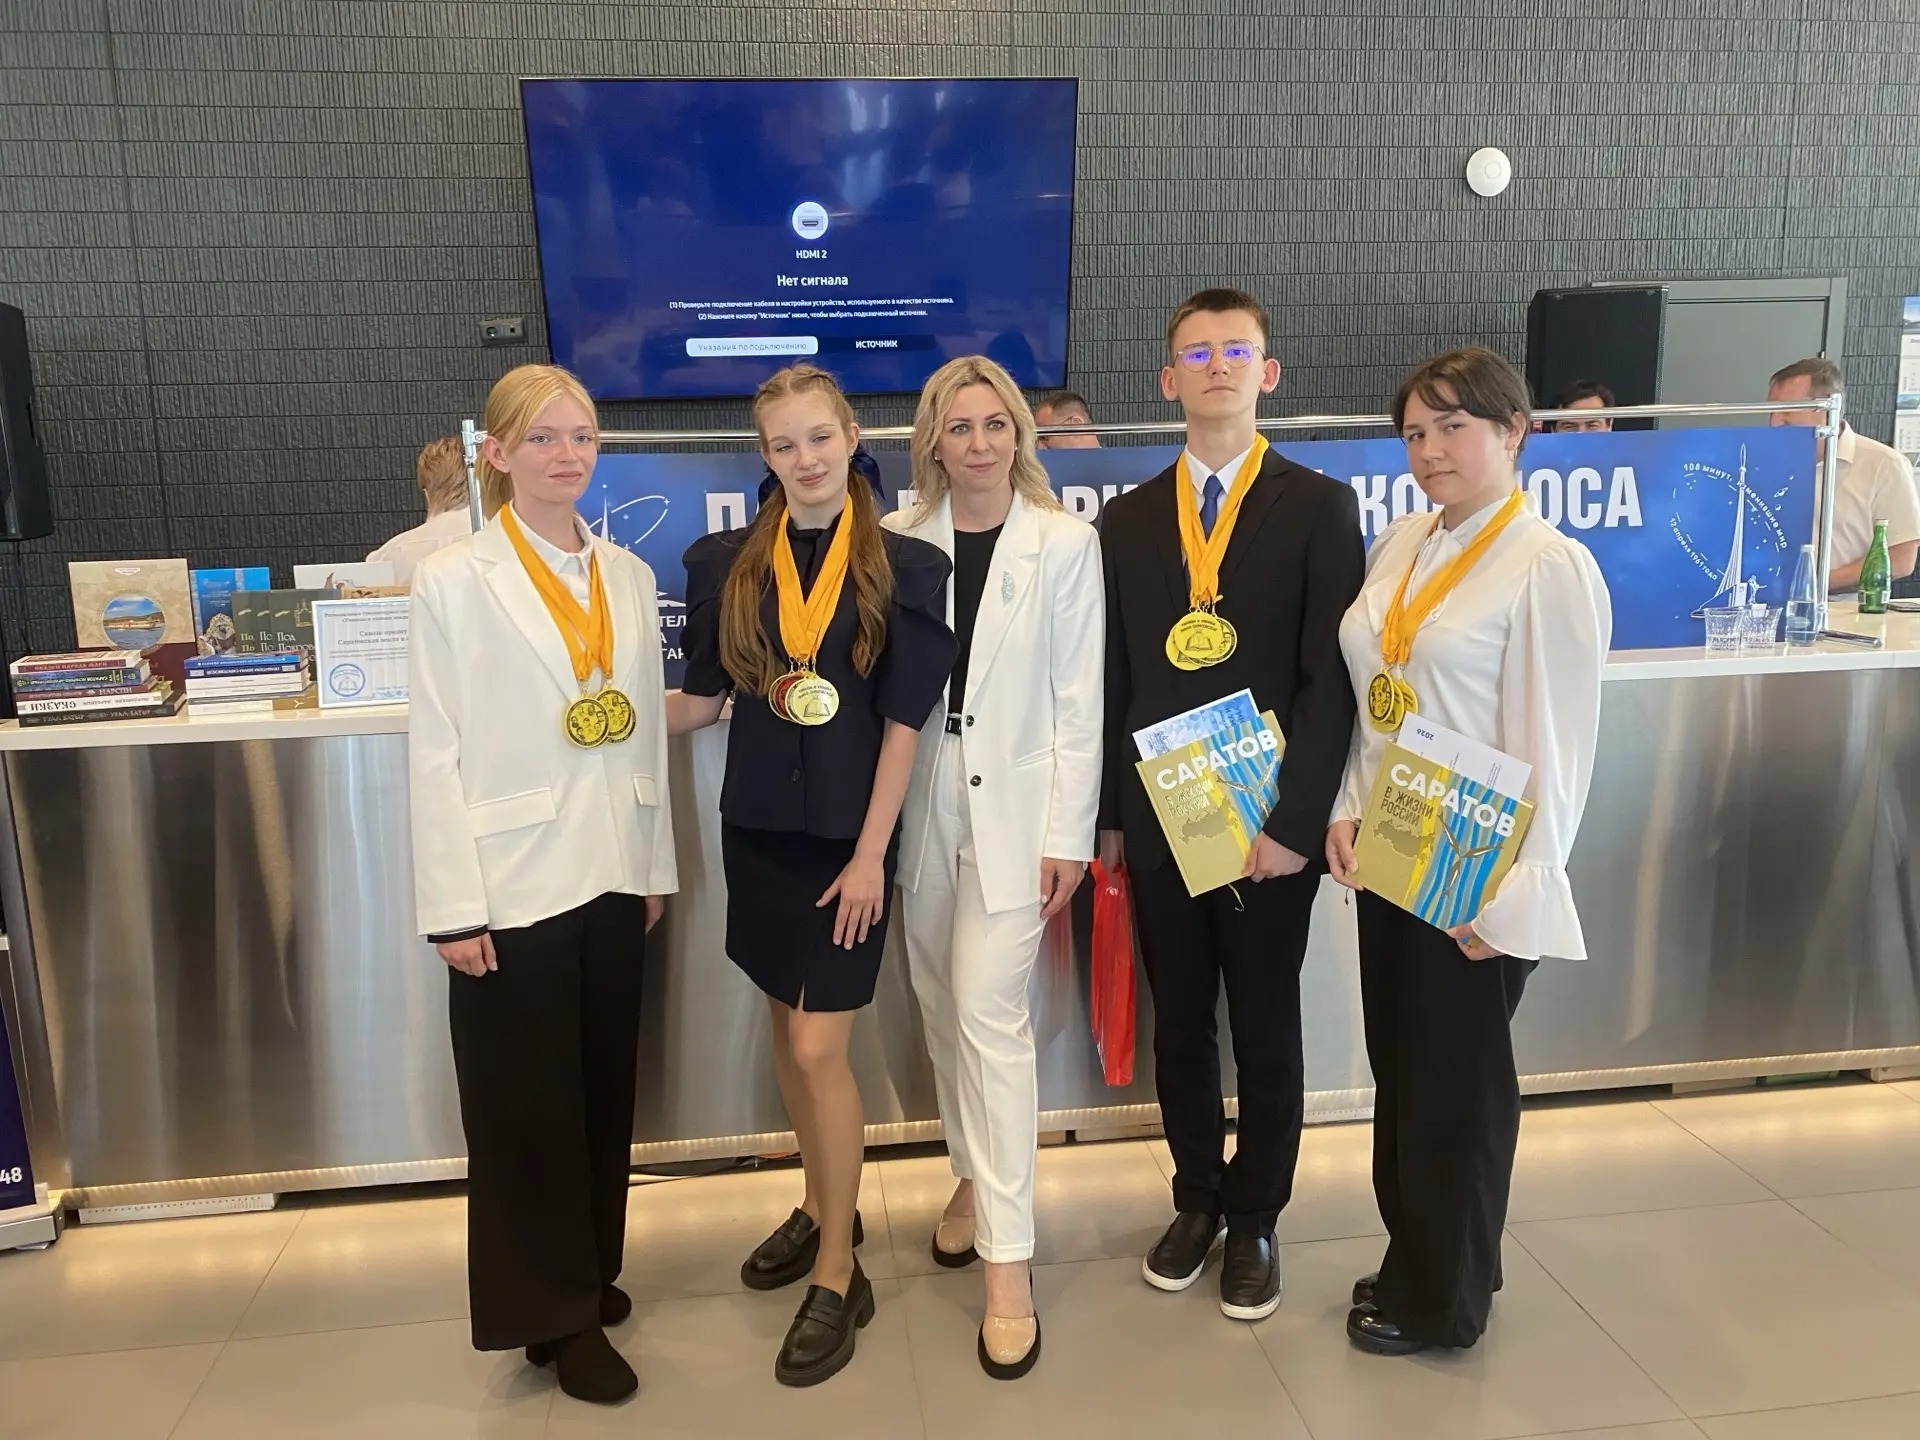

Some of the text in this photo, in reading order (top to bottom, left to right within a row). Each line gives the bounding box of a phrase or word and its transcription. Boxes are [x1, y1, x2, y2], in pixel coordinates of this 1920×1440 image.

[796, 250, 827, 259] HDMI 2
[777, 275, 848, 288] Нет сигнала
[669, 301, 678, 309] (1)
[678, 301, 710, 309] Проверьте
[711, 301, 753, 309] подключение
[698, 312, 707, 320] (2)
[810, 310, 828, 318] чтобы
[829, 310, 853, 318] выбрать
[698, 344, 737, 352] Указания
[750, 343, 807, 351] подключению
[855, 340, 898, 349] ИСТОЧНИК
[1351, 466, 1643, 537] КООСА
[1683, 463, 1701, 471] 108
[1702, 464, 1733, 482] минут,
[1776, 528, 1788, 549] мир
[1669, 517, 1718, 581] 12 апреля 1961 года
[30, 700, 77, 712] СКАЗКИ
[1416, 728, 1435, 740] 2026
[1156, 729, 1278, 790] САРАТОВ
[1384, 785, 1434, 820] В ЖИЗНИ
[1390, 763, 1516, 838] САРАТОВ
[1380, 798, 1421, 827] РОССИИ
